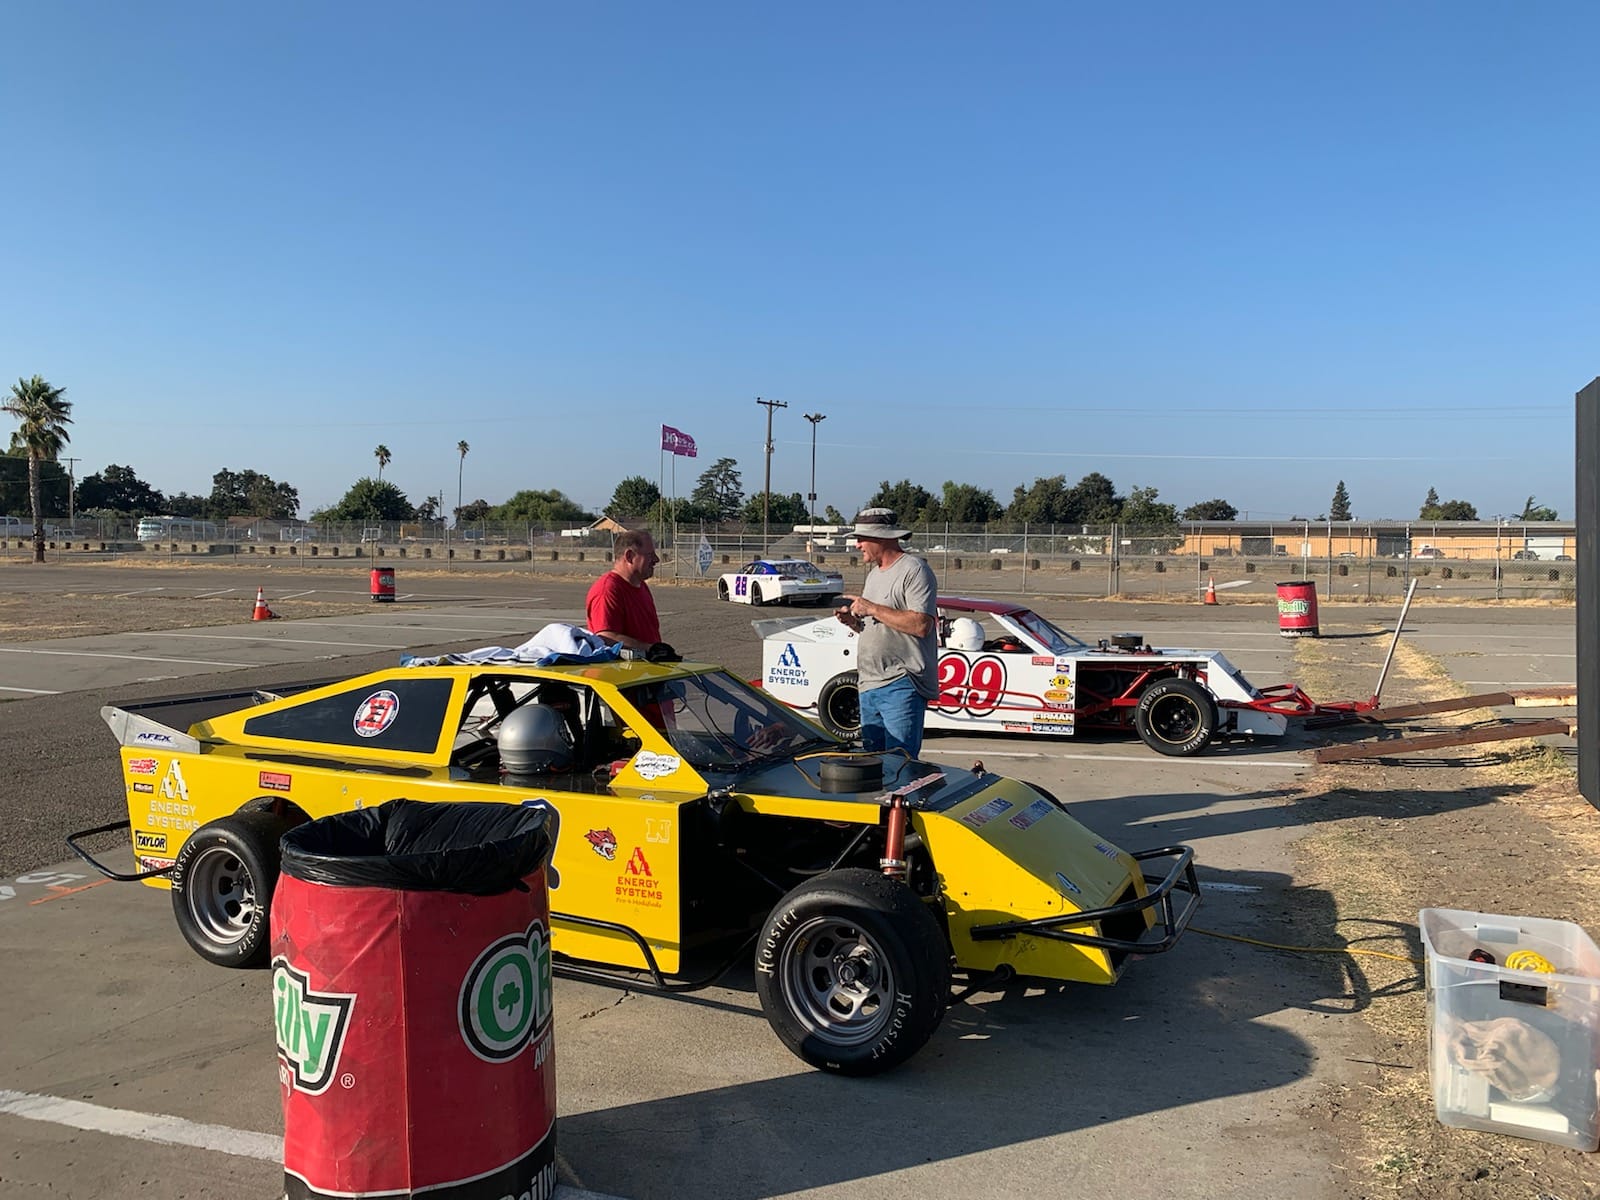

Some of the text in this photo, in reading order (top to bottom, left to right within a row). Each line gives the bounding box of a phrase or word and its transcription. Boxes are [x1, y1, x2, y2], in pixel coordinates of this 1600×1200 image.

[770, 667, 807, 678] ENERGY
[768, 676, 809, 687] SYSTEMS
[938, 654, 1006, 716] 29
[137, 732, 172, 742] AFEX
[150, 800, 197, 817] ENERGY
[147, 814, 200, 832] SYSTEMS
[137, 835, 166, 849] TAYLOR
[617, 876, 659, 888] ENERGY
[615, 886, 663, 900] SYSTEMS
